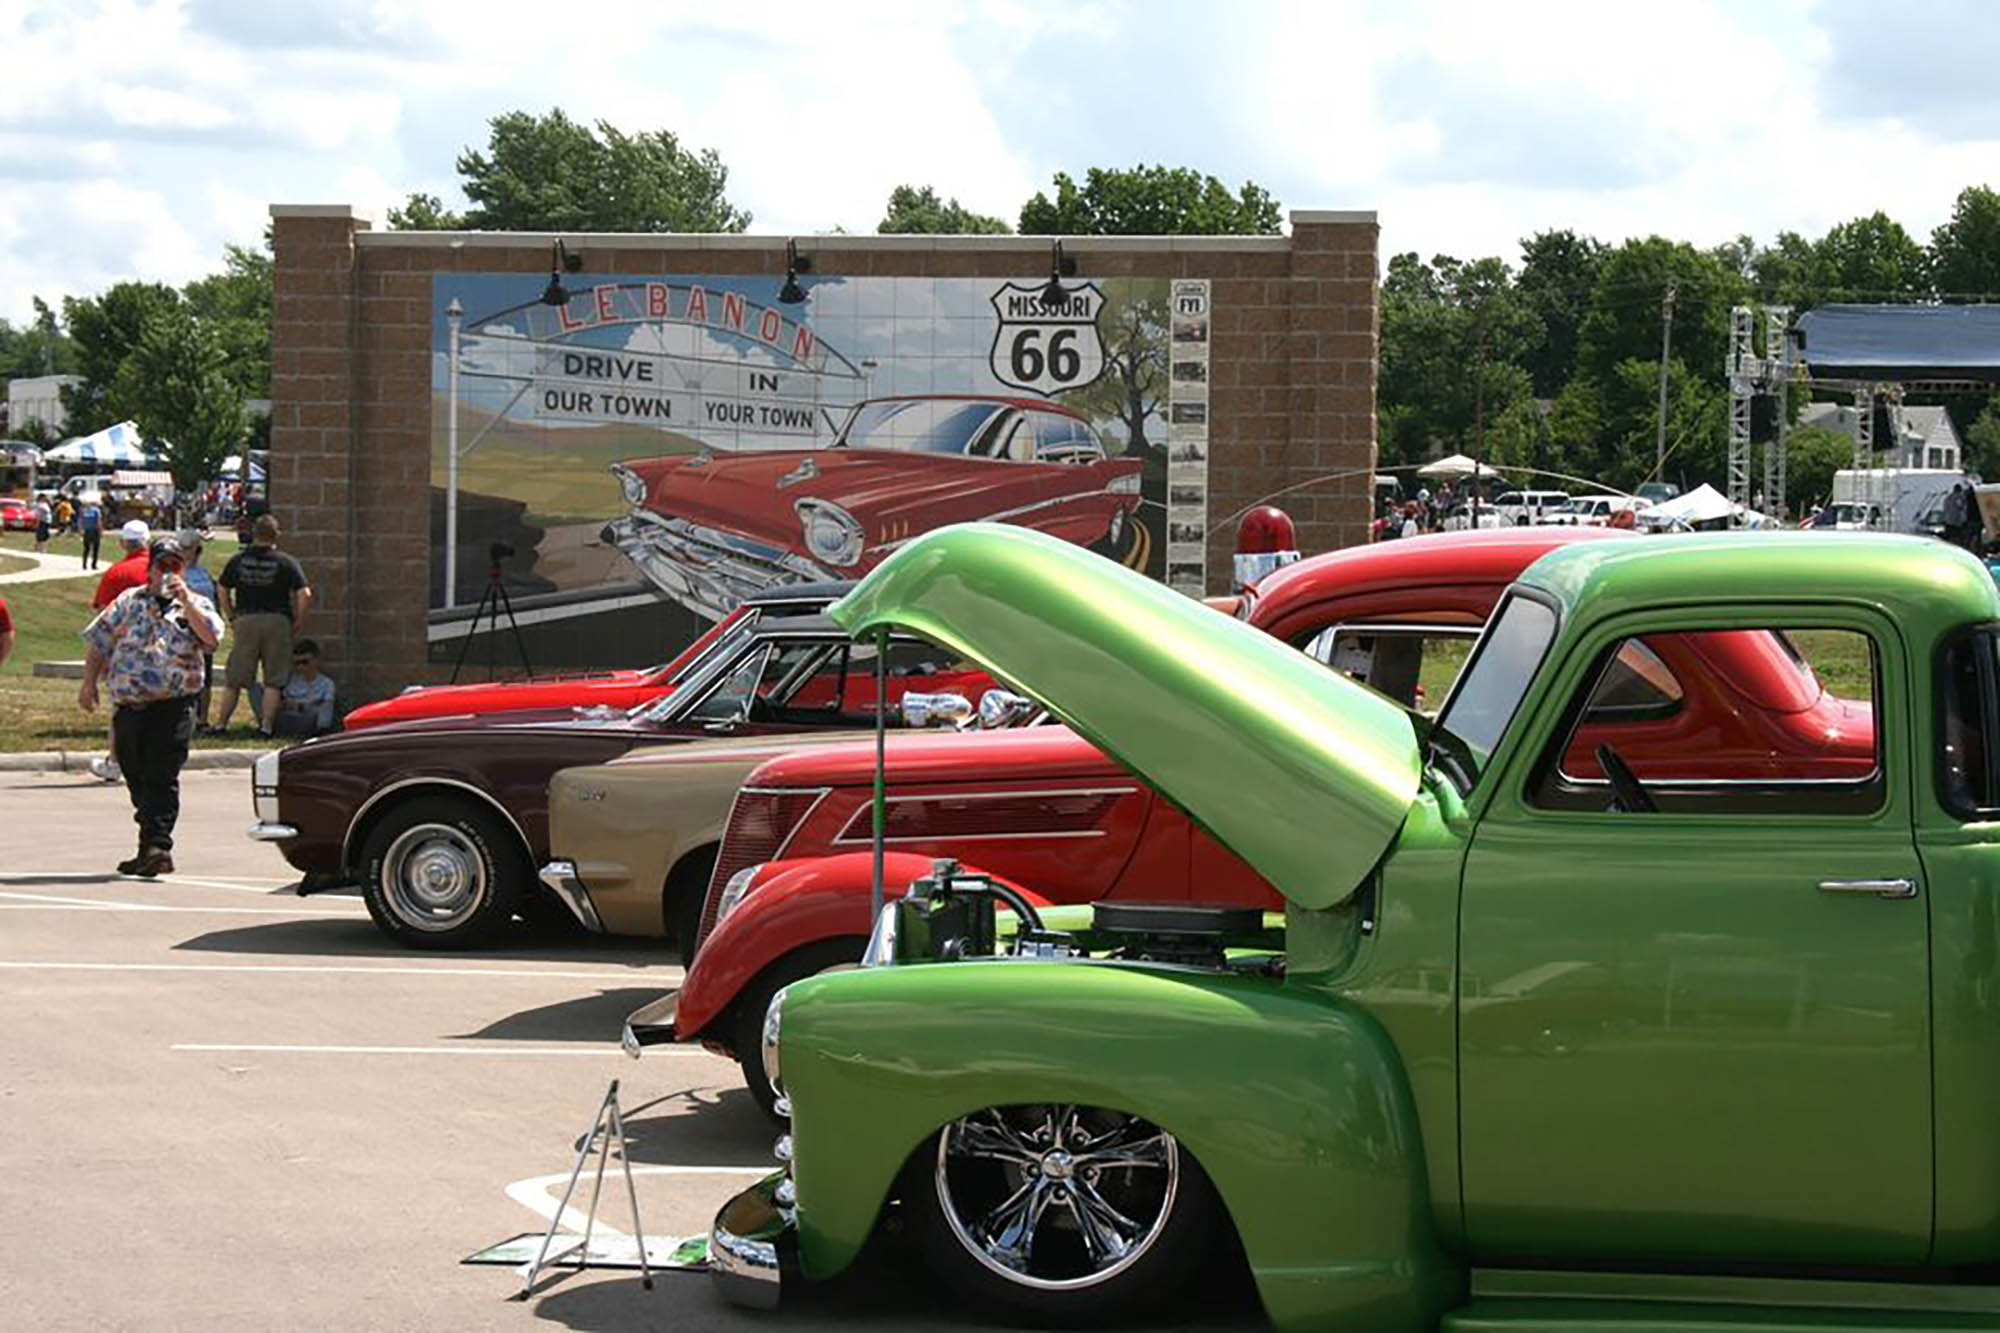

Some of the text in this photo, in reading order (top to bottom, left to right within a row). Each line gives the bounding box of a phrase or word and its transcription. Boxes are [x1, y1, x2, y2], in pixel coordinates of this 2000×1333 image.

[559, 283, 817, 361] LEBANON
[1008, 296, 1090, 317] MISSOURI
[1011, 328, 1081, 383] 66
[564, 353, 779, 392] DRIVE IN
[544, 390, 671, 418] OUR TOWN
[705, 401, 814, 429] YOUR TOWN
